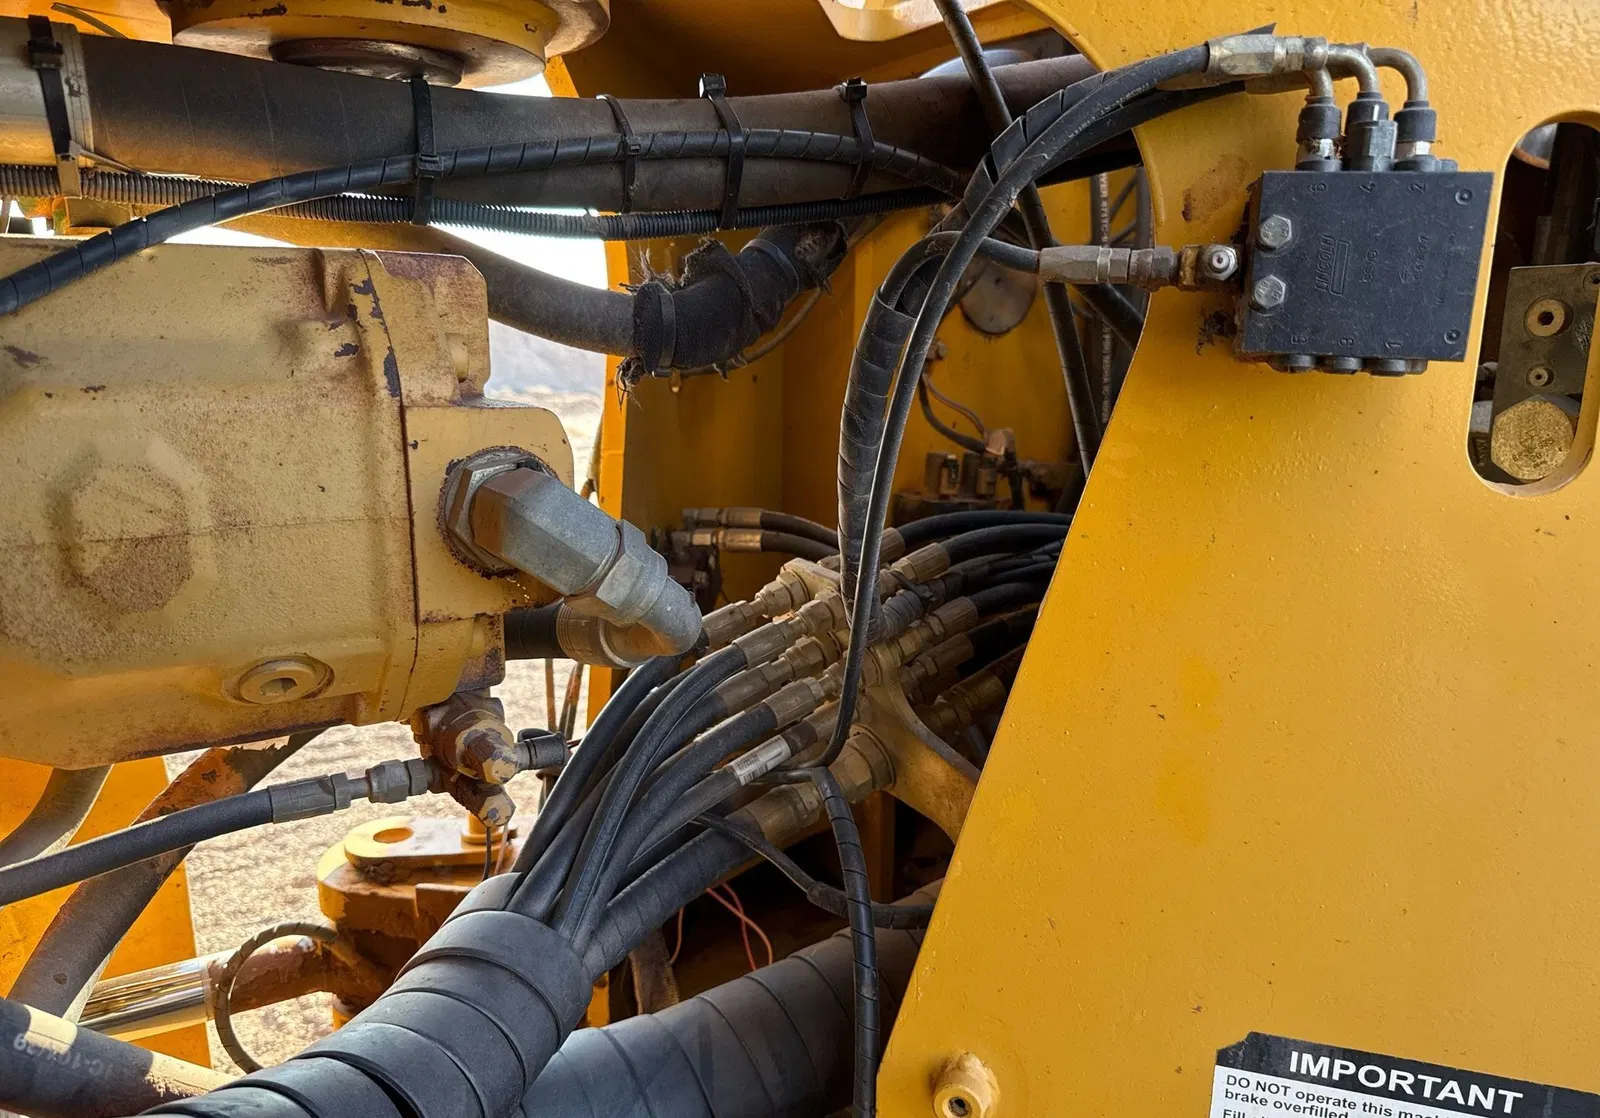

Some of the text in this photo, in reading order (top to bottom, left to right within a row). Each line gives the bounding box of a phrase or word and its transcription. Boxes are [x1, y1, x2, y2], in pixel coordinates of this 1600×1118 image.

[1310, 181, 1327, 193] 6
[1359, 181, 1376, 195] 4
[1409, 181, 1427, 195] 2
[1315, 234, 1336, 292] LINCOLN
[1338, 337, 1354, 348] 3
[1289, 1050, 1524, 1114] IMPORTANT
[1224, 1087, 1349, 1118] brake overfilled
[1226, 1074, 1251, 1089] DO
[1255, 1080, 1291, 1097] NOT
[1295, 1090, 1357, 1110] operate
[1362, 1101, 1393, 1117] this
